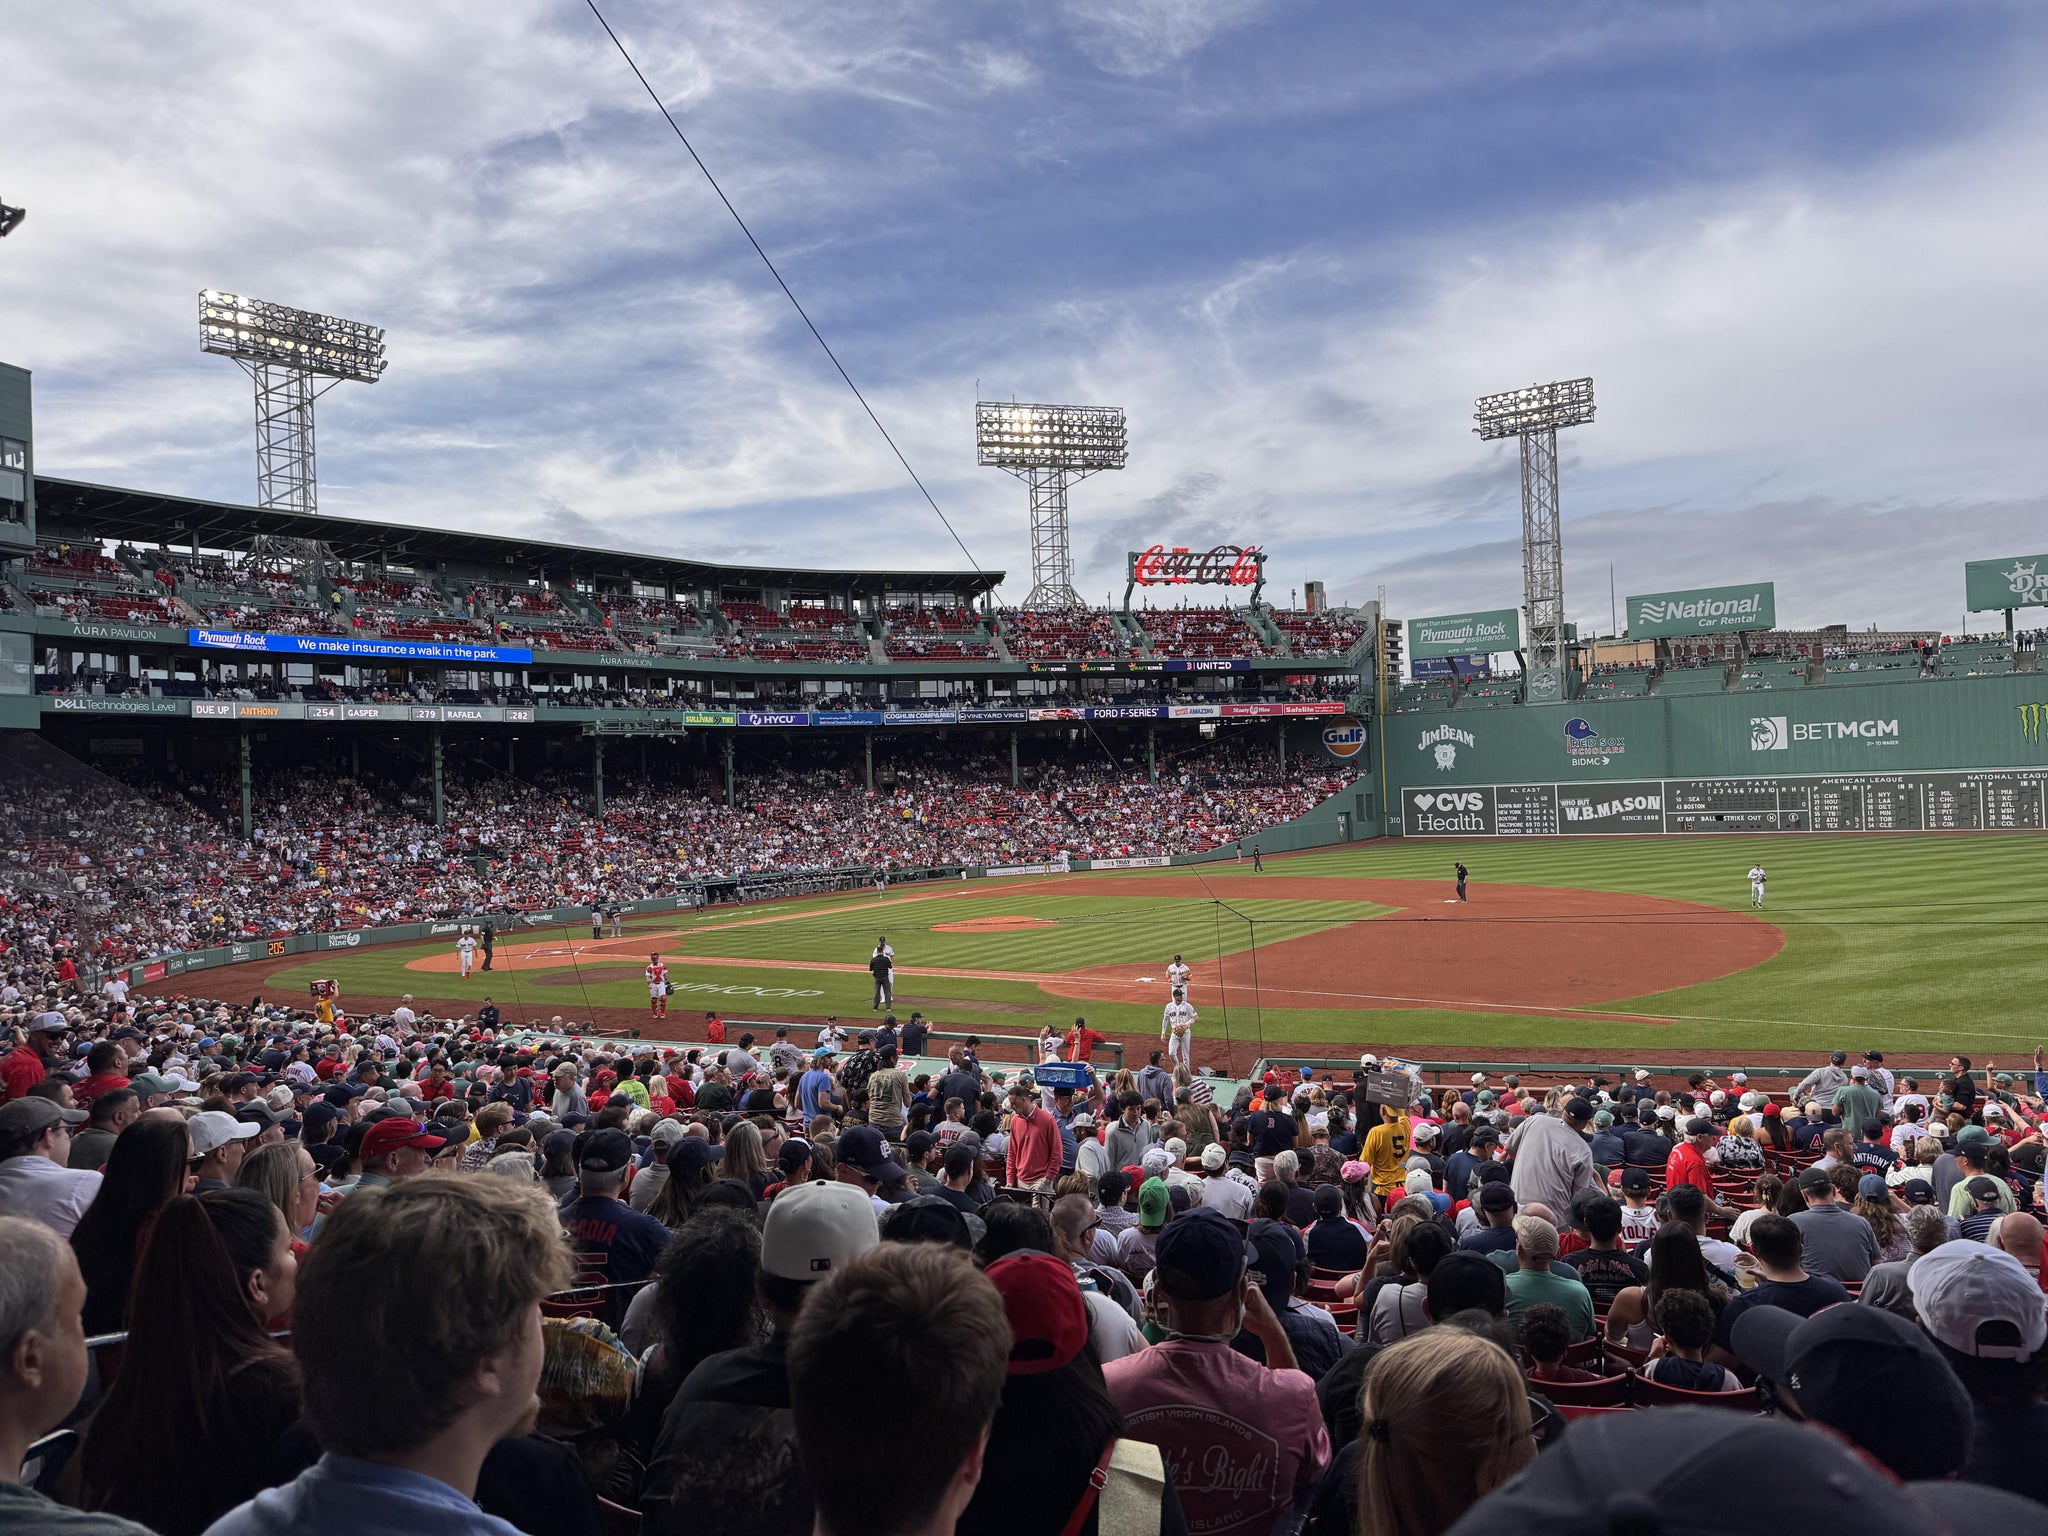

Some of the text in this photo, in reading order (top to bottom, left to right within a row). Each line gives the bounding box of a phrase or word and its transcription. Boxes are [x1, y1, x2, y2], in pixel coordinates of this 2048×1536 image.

[1135, 545, 1262, 585] Coca-Cola
[1666, 594, 1760, 620] National
[1699, 614, 1756, 628] Car Rental
[111, 628, 157, 640] PAVILION
[198, 630, 266, 646] Plymouth Rock
[1420, 621, 1505, 642] Plymouth Rock
[297, 639, 499, 661] We make insurance a walk in the park.
[623, 658, 652, 667] PAVILION
[1196, 661, 1232, 670] UNITED
[54, 698, 176, 713] DELL Technologies Level
[196, 705, 215, 715] DUE
[217, 705, 230, 715] UP
[240, 707, 279, 717] ANTHONY
[312, 708, 335, 717] .254
[347, 709, 379, 718] GASPER
[416, 710, 436, 719] .279
[447, 711, 482, 719] RAFAELA
[1189, 707, 1214, 715] AMAZING
[1232, 705, 1271, 715] Ninety Nine
[1285, 706, 1314, 714] Safelite
[685, 714, 734, 724] SULLIVAN TIRE
[763, 715, 794, 724] HYCU
[885, 712, 955, 720] COGHLIN COMPANIES
[966, 712, 1025, 720] VINEYARD VINES
[1094, 707, 1159, 719] FORD F-SERIES
[1326, 729, 1364, 743] Gulf
[1793, 719, 1899, 741] BETMGM
[1418, 724, 1475, 751] JIM BEAM
[1571, 737, 1625, 748] RED SOX
[1571, 746, 1625, 755] SCHOLARS
[1572, 757, 1600, 766] BIDMC
[1821, 777, 1866, 785] AMERICAN
[1967, 773, 2013, 781] NATIONAL
[1436, 792, 1483, 811] CVS
[1565, 795, 1661, 821] W.B.MASON
[1417, 813, 1485, 831] Health
[430, 923, 459, 935] Franklin
[328, 934, 347, 942] Ninety
[268, 941, 285, 956] 205
[1267, 1117, 1276, 1129] B
[1391, 1135, 1406, 1159] 5
[1852, 1152, 1890, 1169] ANTHONY
[1165, 1409, 1203, 1421] VIRGIN
[1204, 1412, 1253, 1440] ISLANDS
[1202, 1444, 1270, 1500] Bight
[1190, 1508, 1244, 1530] ISLAND
